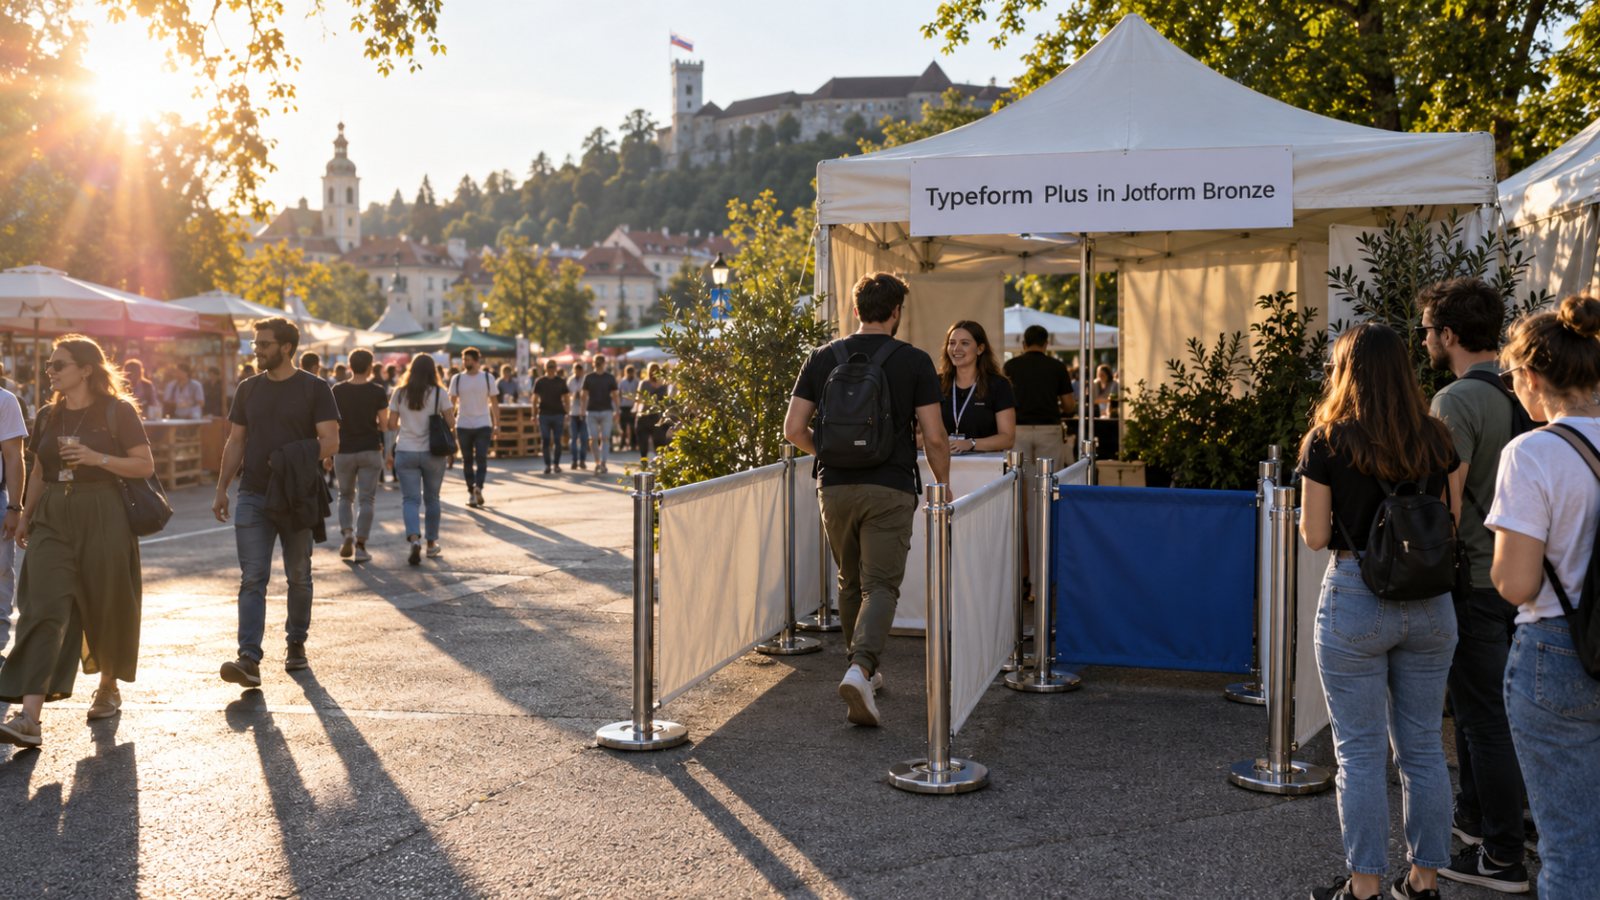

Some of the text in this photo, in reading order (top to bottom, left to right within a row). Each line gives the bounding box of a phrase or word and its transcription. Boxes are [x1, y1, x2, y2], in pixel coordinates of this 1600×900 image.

[925, 182, 1275, 210] Typeform Plus in Jotform Bronze
